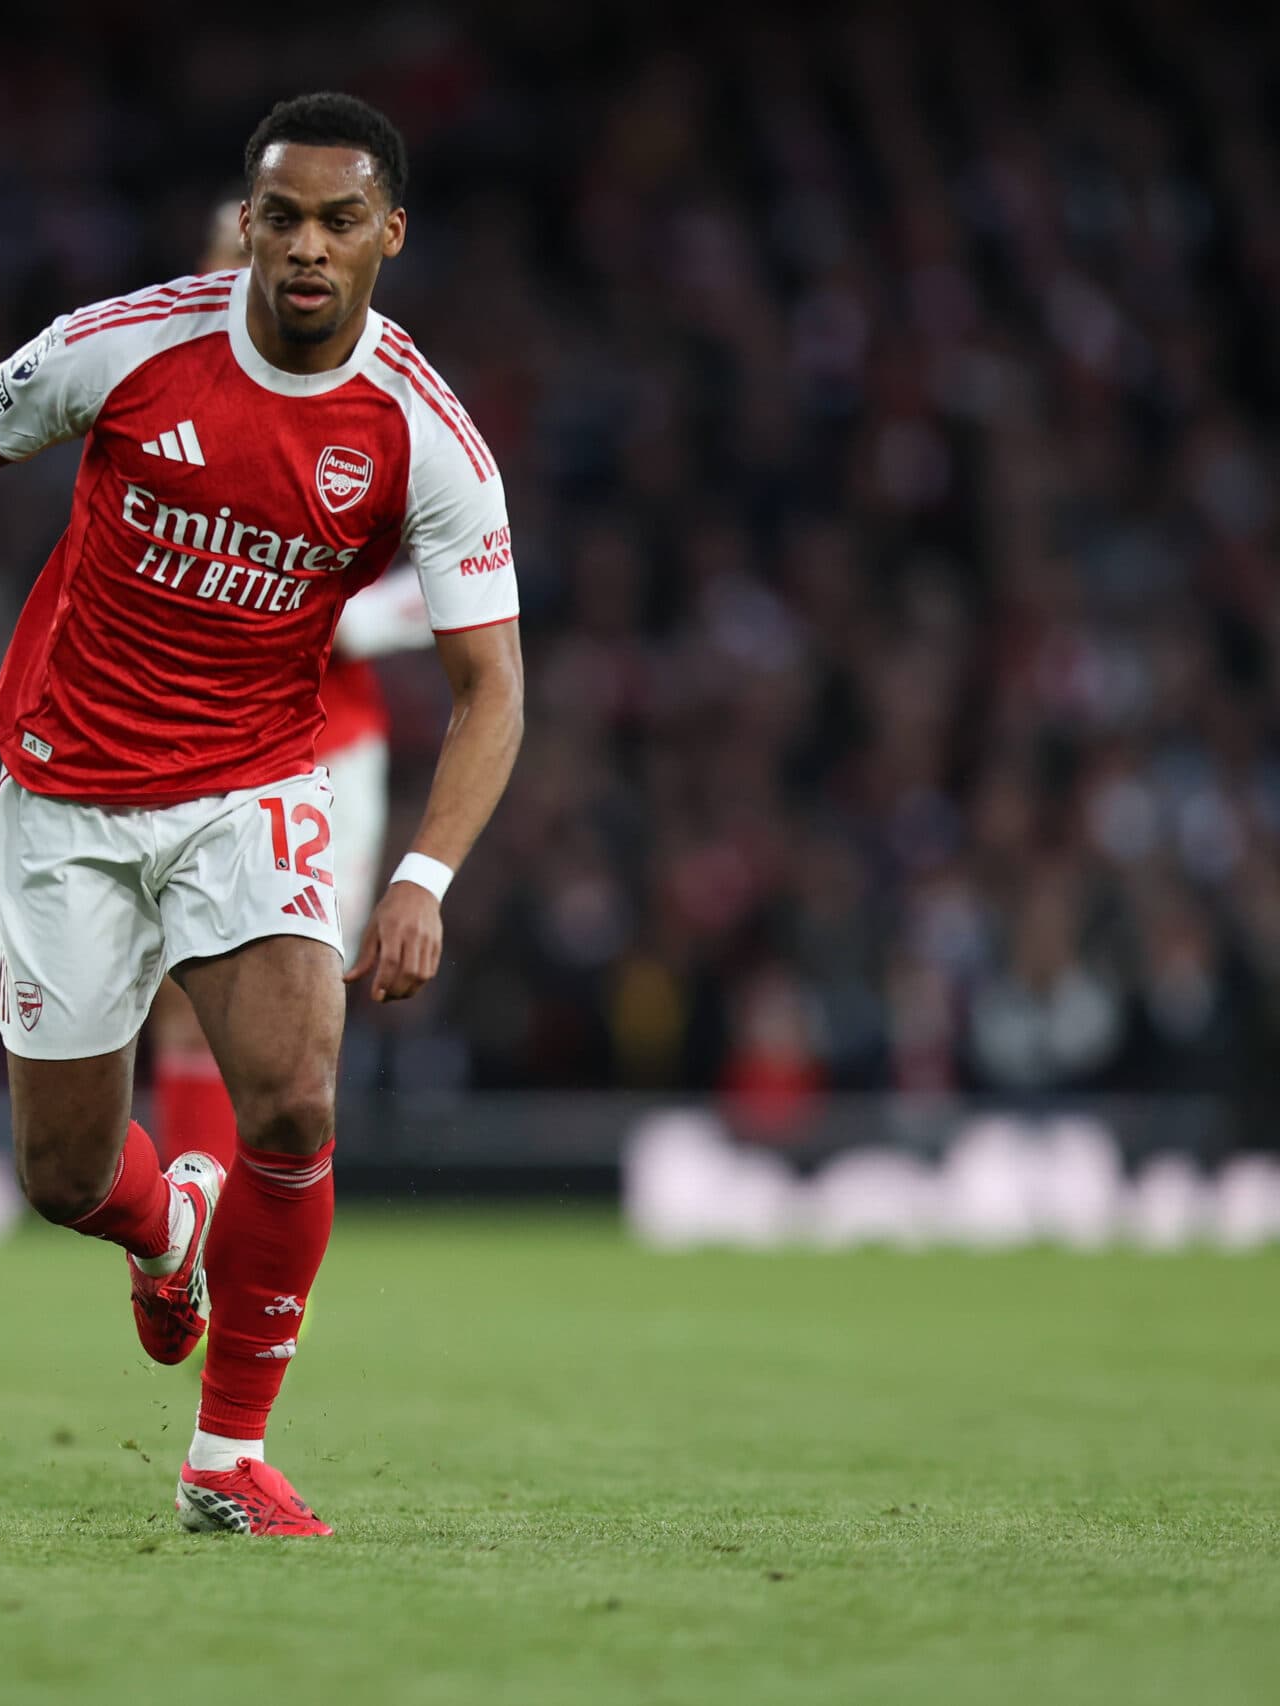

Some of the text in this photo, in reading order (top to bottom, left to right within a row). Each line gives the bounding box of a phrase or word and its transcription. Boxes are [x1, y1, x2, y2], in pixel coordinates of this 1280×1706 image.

[326, 455, 367, 476] Arsenal
[122, 482, 360, 572] Emirates
[135, 544, 313, 612] FLY BETTER
[258, 797, 334, 888] 12
